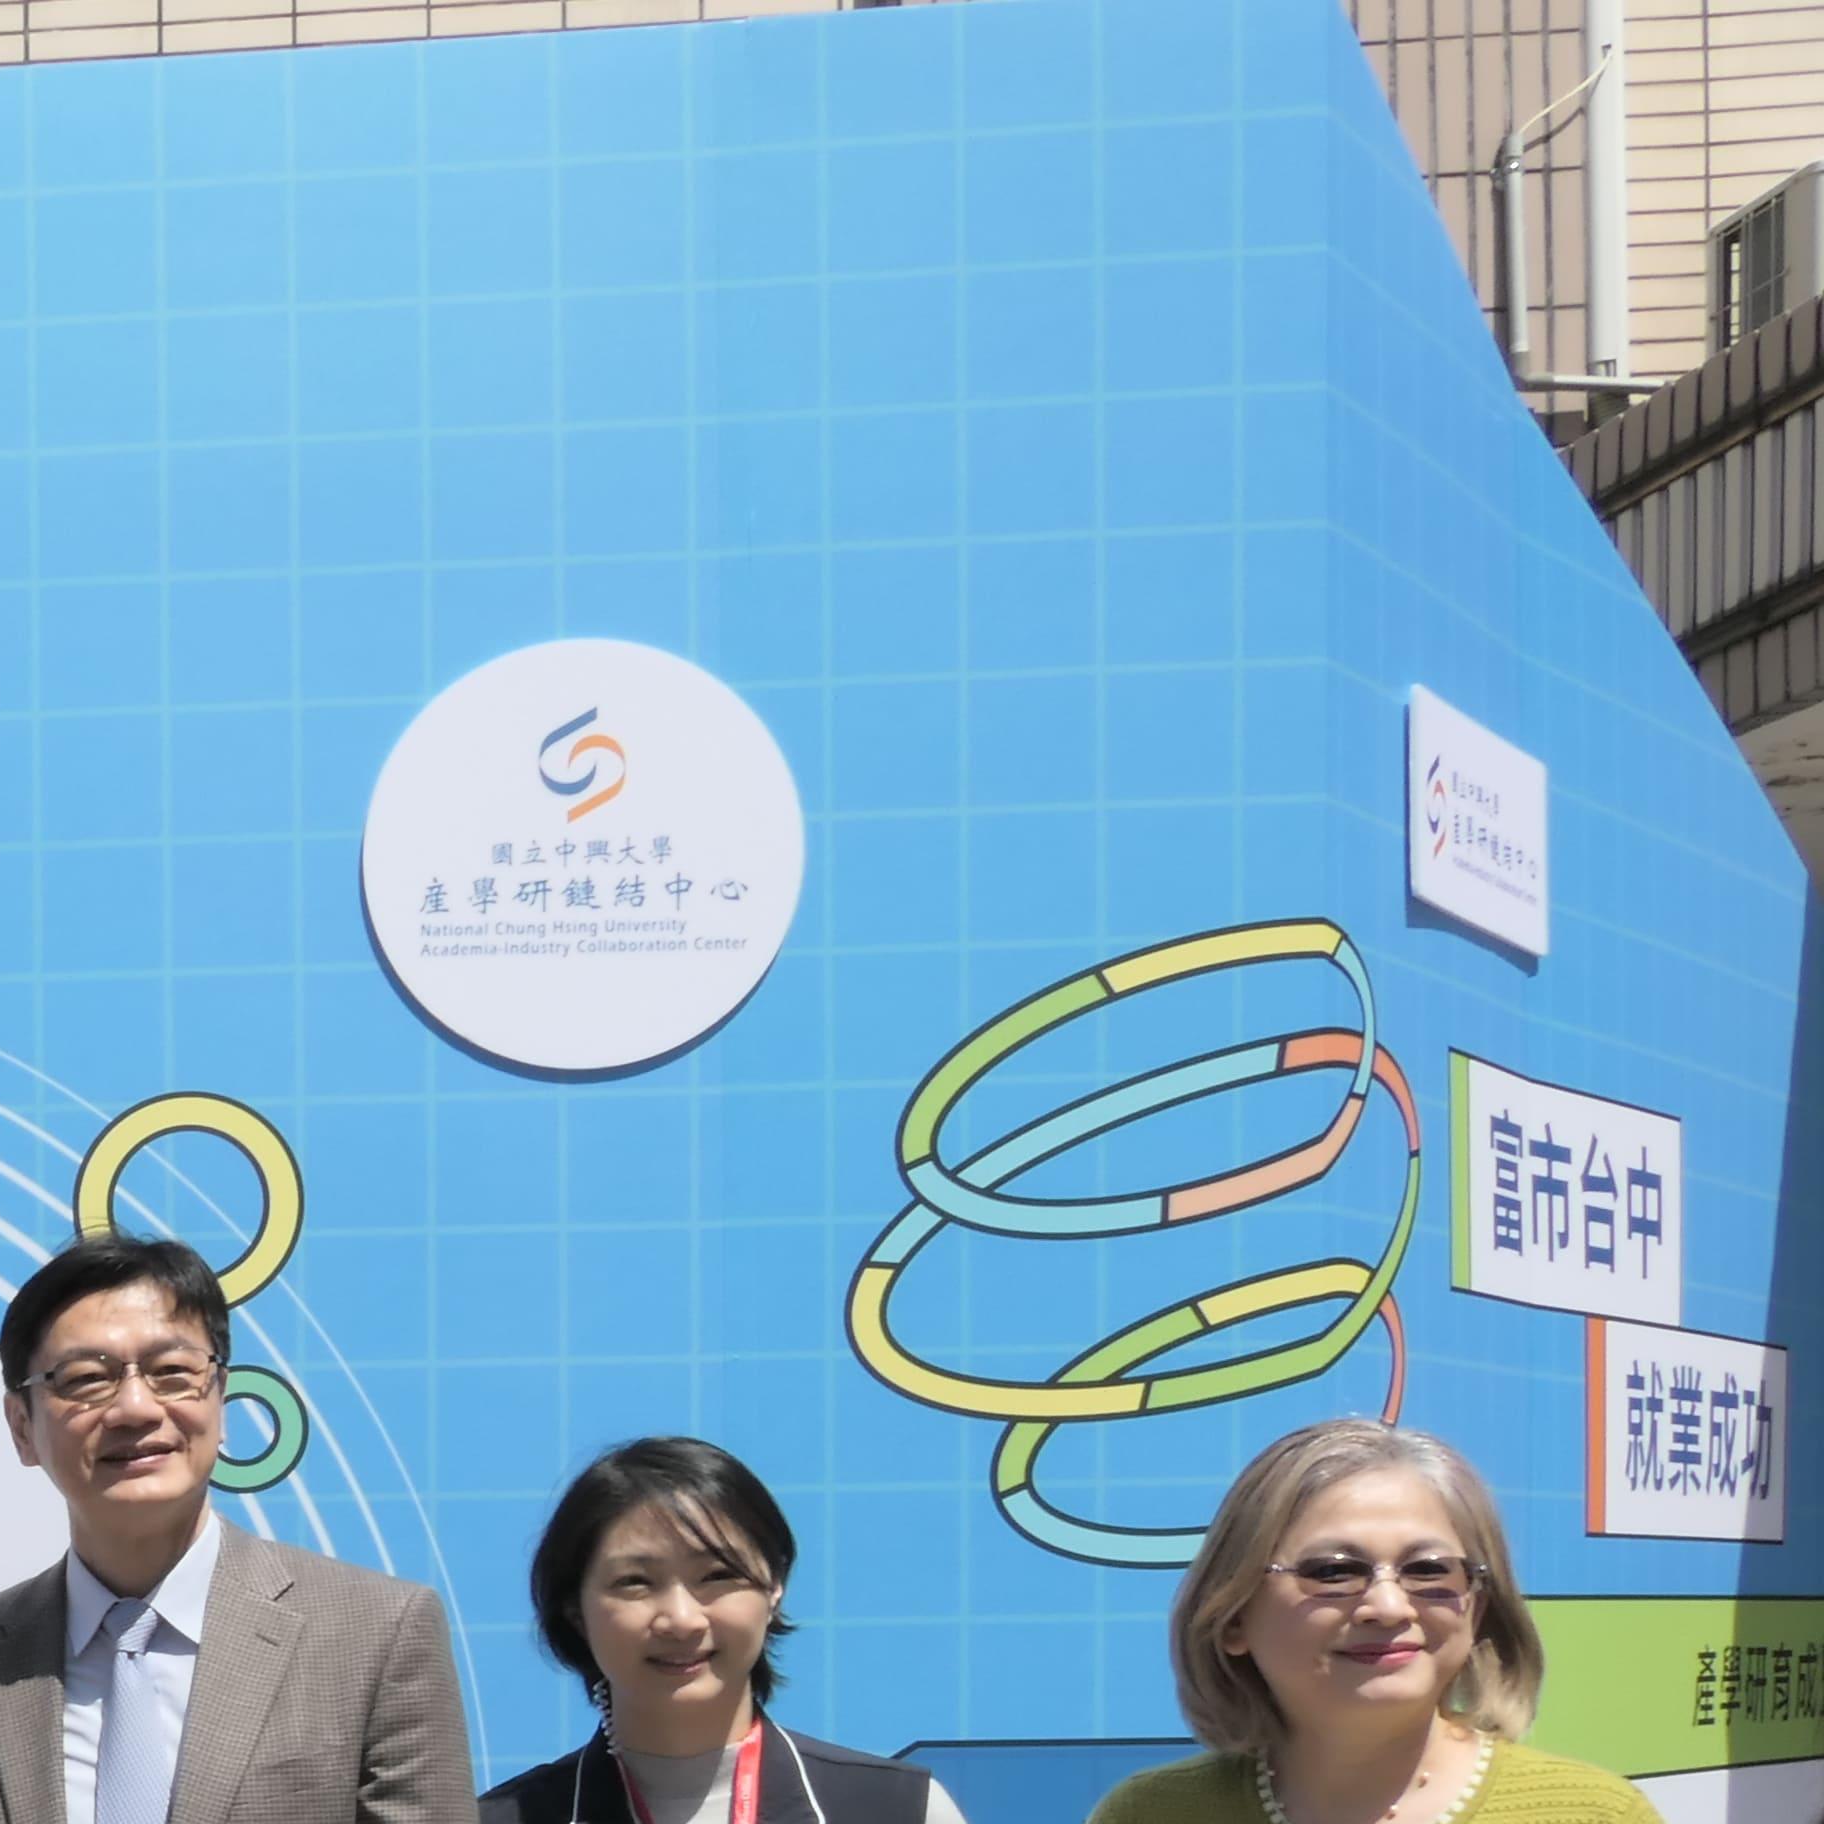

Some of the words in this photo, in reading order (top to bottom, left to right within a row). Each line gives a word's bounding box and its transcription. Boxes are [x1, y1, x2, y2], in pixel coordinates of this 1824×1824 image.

[491, 834, 673, 868] 國立中興大學
[419, 872, 749, 915] 產學研鏈結中心
[420, 922, 489, 938] National
[495, 921, 546, 939] Chung
[553, 920, 598, 938] Hsing
[604, 918, 688, 937] University
[420, 941, 571, 959] Academia-Industry
[576, 938, 688, 954] Collaboration
[694, 936, 748, 951] Center
[1489, 1108, 1663, 1281] 富市台中
[1625, 1359, 1773, 1501] 就業成功
[1692, 1642, 1824, 1728] 產學研育成
